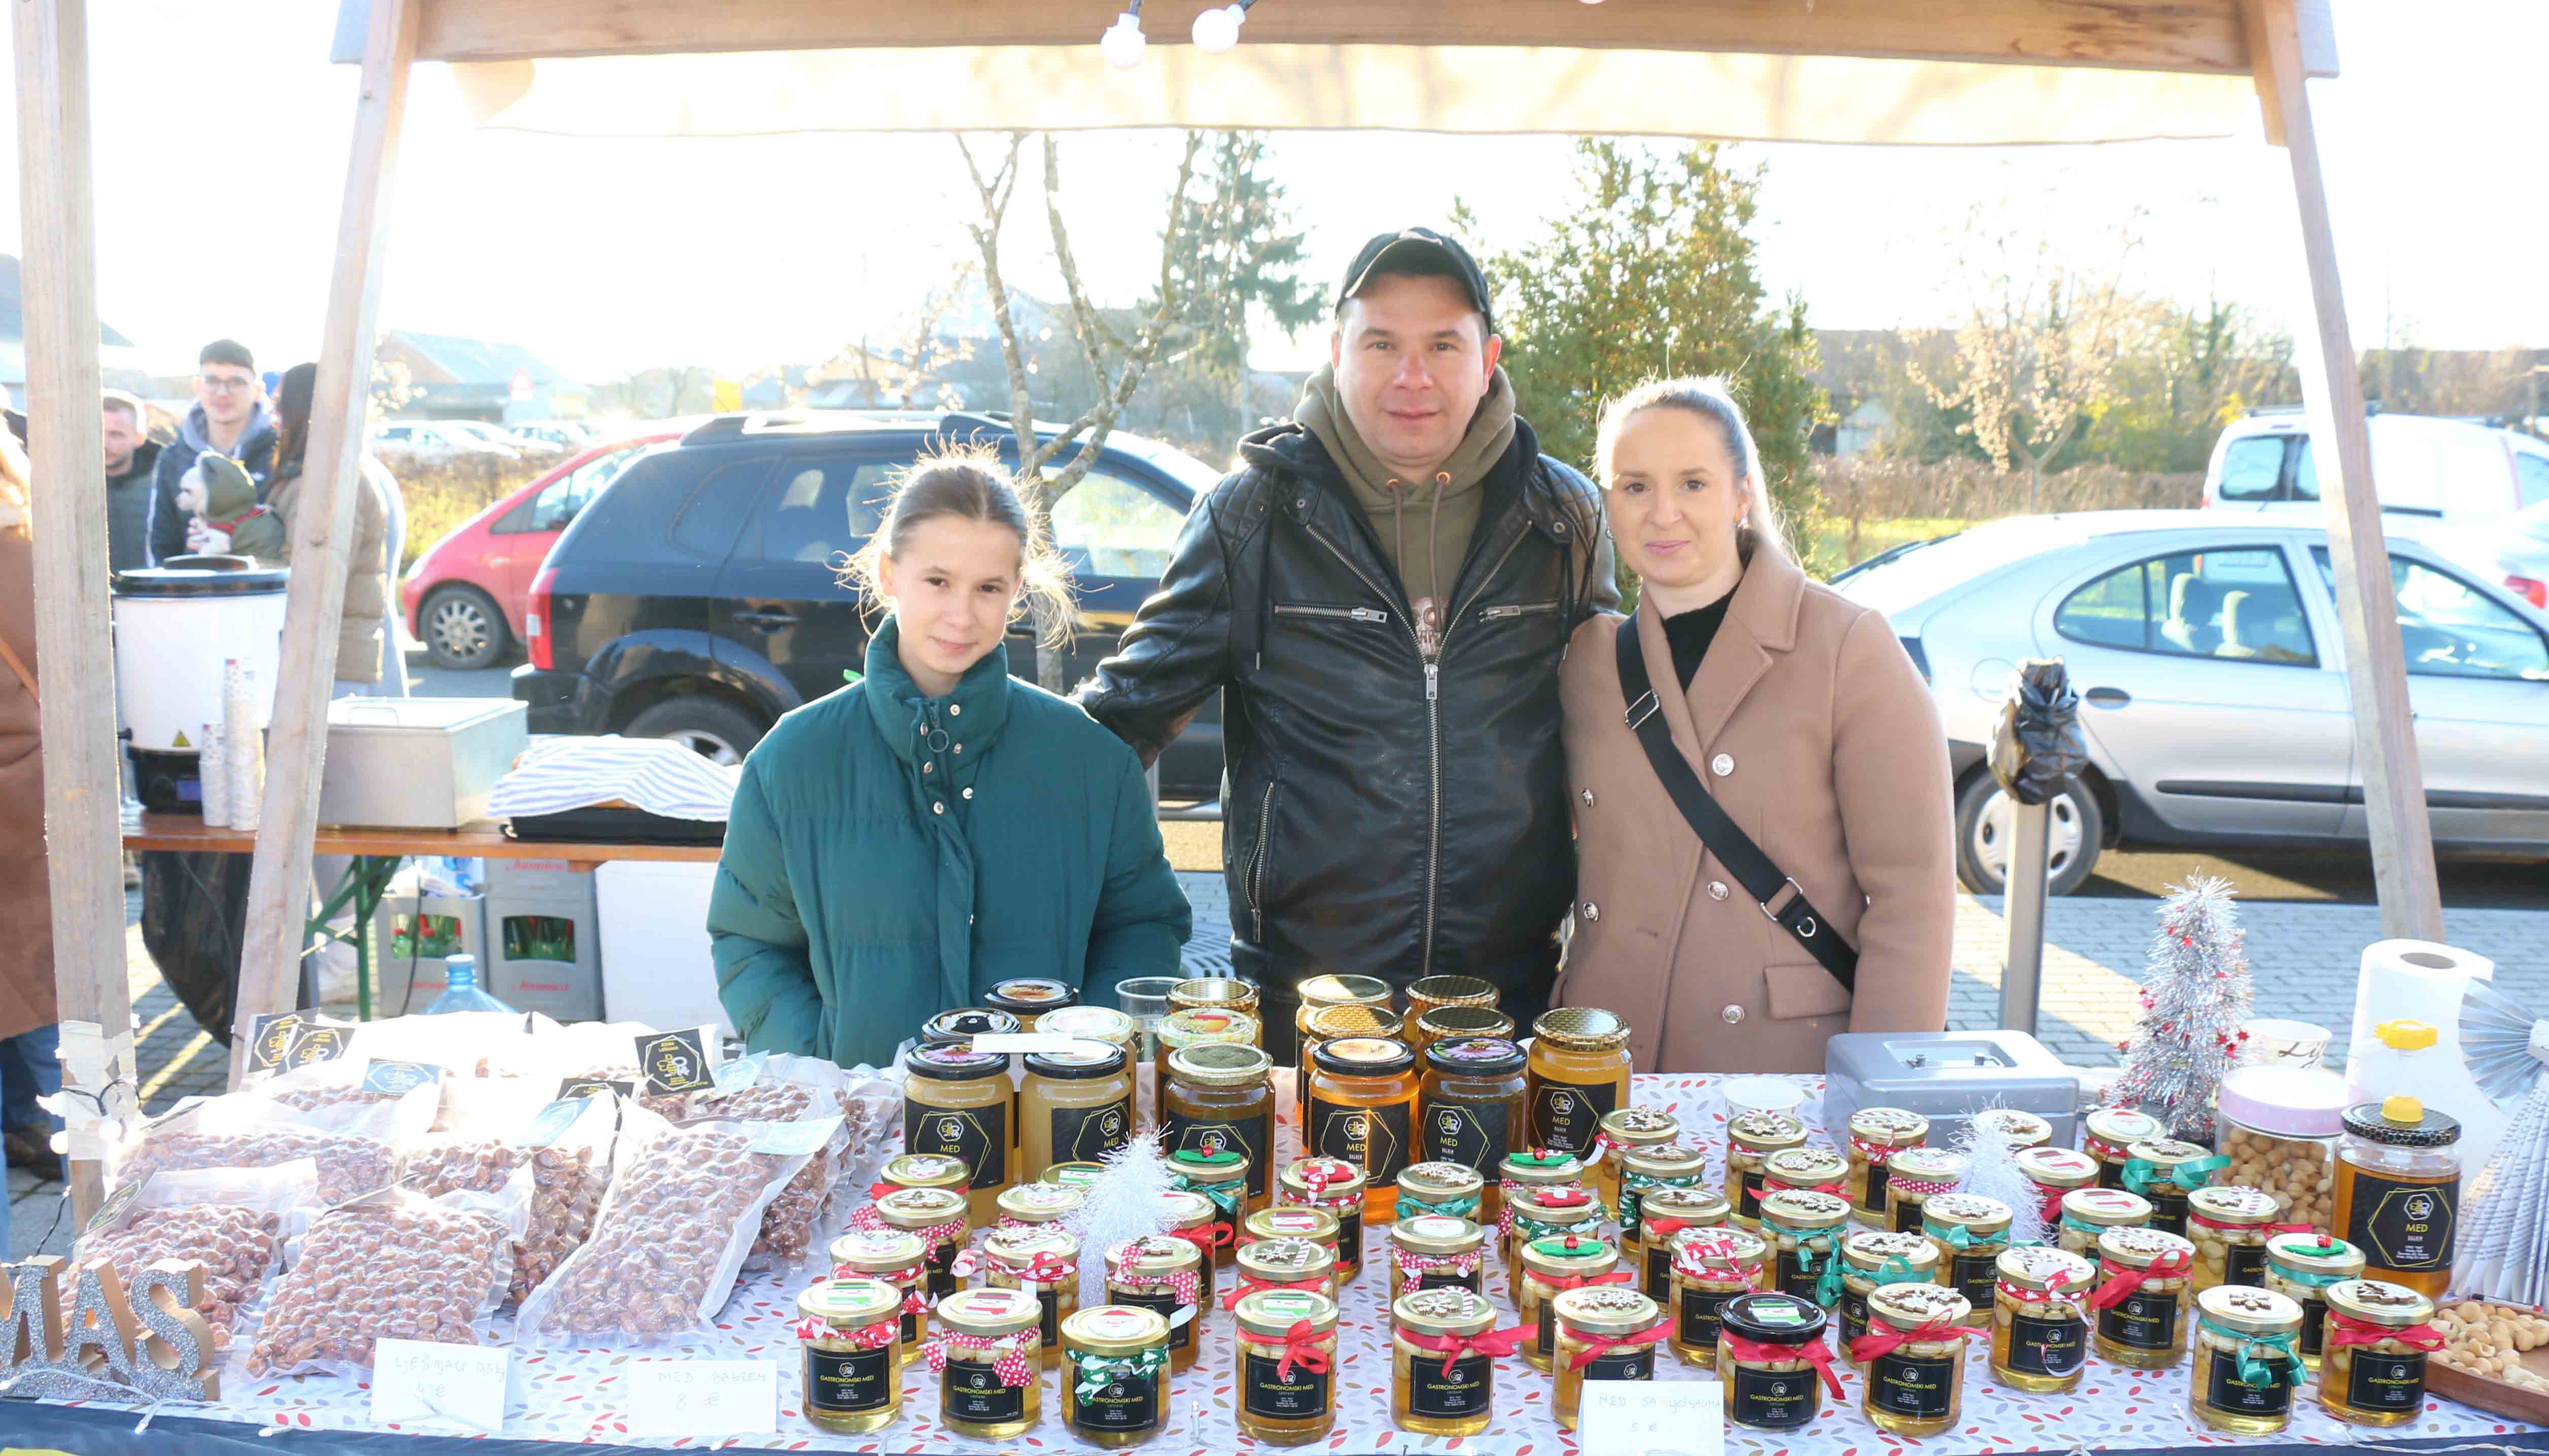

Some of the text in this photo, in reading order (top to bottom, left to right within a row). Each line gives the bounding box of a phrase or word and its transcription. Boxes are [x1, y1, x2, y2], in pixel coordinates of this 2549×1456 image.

[1552, 1116, 1571, 1125] MED
[1104, 1137, 1119, 1148] MED
[1440, 1137, 1458, 1147] MED
[940, 1144, 960, 1153] MED
[1347, 1143, 1366, 1152] MED
[2405, 1223, 2428, 1233] MED
[657, 1371, 695, 1384] MED
[820, 1374, 862, 1382] GASTRONOMSKI
[1883, 1376, 1924, 1389] GASTRONOMSKI
[953, 1385, 993, 1395] GASTRONOMSKI
[1260, 1382, 1302, 1391] GASTRONOMSKI
[674, 1392, 719, 1412] 8 €
[1599, 1395, 1626, 1408] MED
[1642, 1396, 1657, 1407] SA
[1750, 1393, 1792, 1402] GASTRONOMSKI
